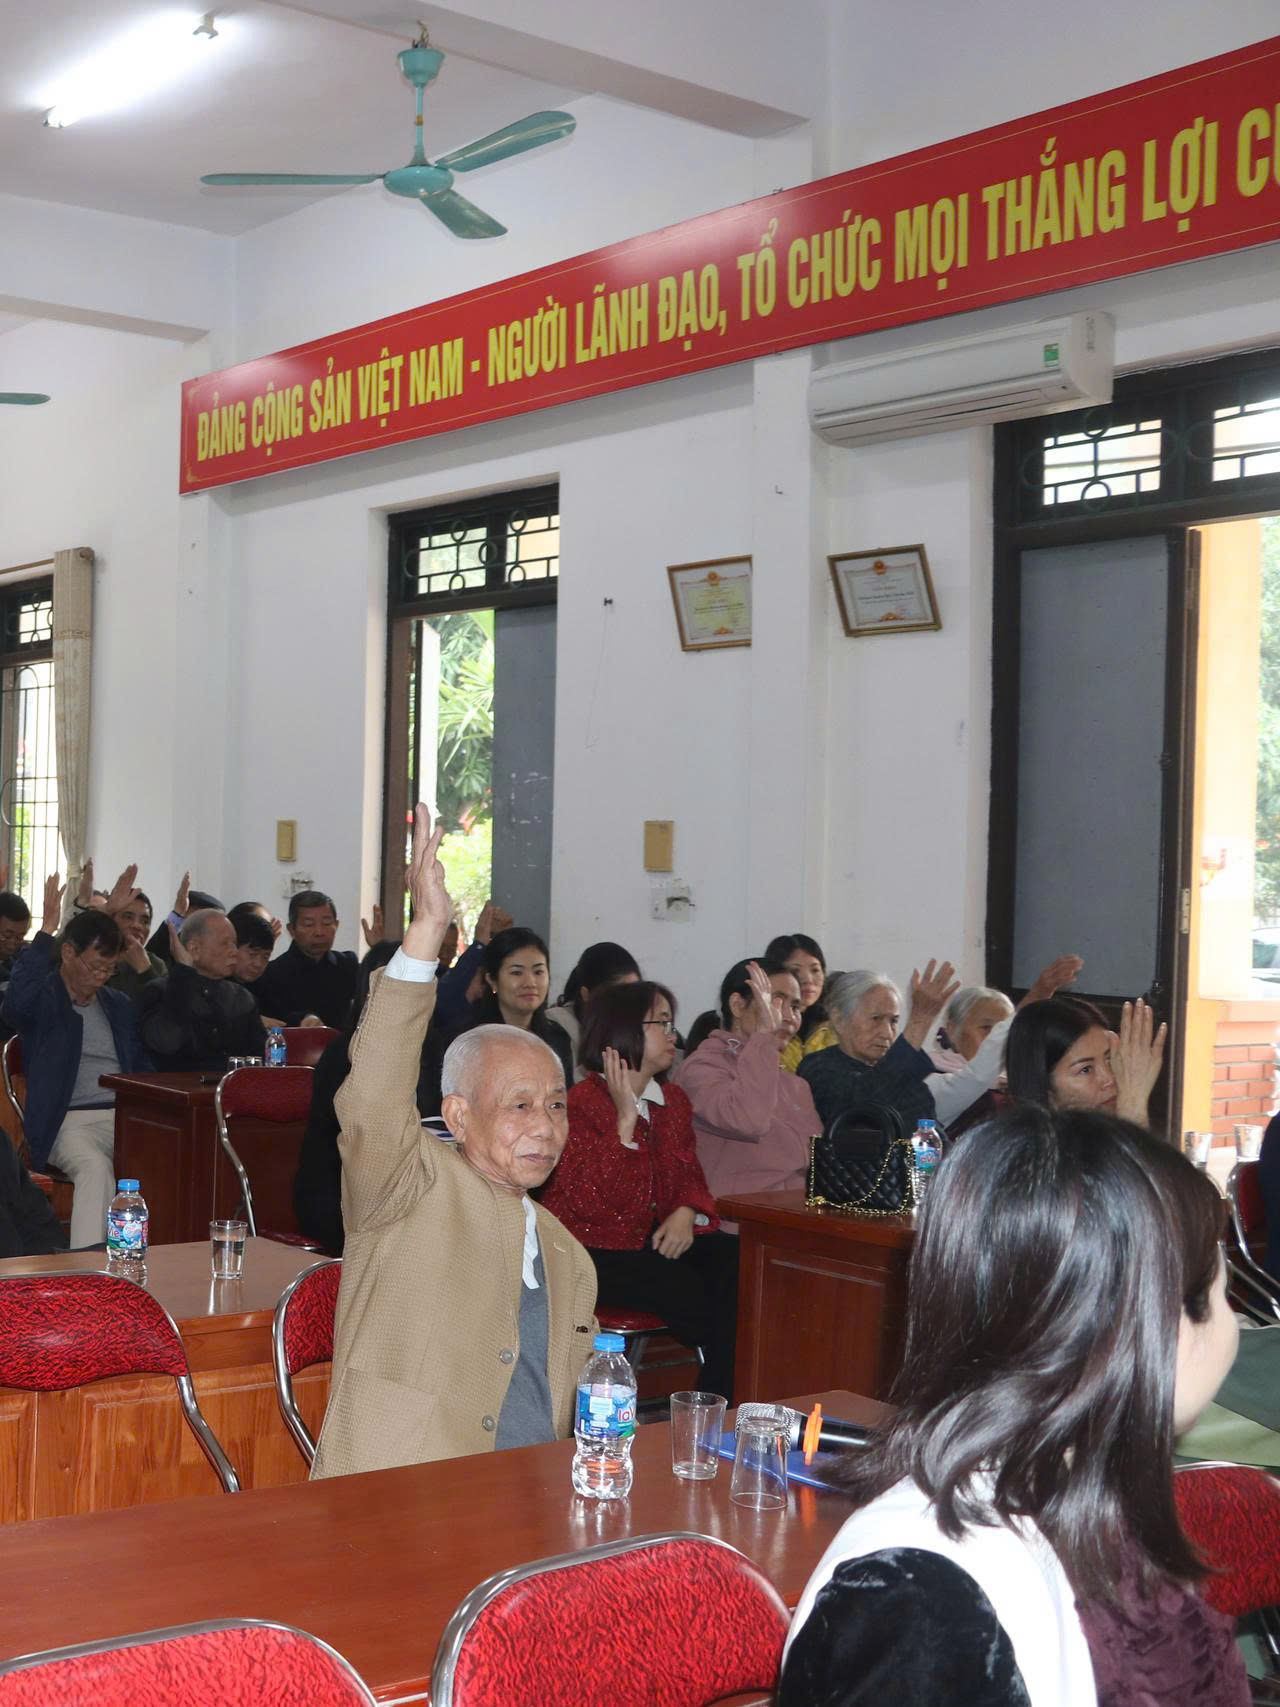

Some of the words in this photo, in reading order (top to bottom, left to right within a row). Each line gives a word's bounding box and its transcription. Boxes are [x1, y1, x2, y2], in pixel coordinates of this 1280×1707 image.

[197, 390, 246, 461] ĐẢNG
[251, 385, 304, 456] CỘNG
[309, 356, 351, 432] SẢN
[357, 348, 403, 427] VIỆT
[408, 338, 464, 407] NAM
[470, 359, 481, 373] -
[487, 295, 567, 387] NGƯỜI
[575, 284, 649, 364] LÃNH
[657, 263, 727, 352] ĐẠO,
[737, 217, 779, 321] TỔ
[788, 209, 881, 310] CHỨC
[894, 192, 969, 291] MỌI
[982, 136, 1127, 262] THẮNG
[1142, 115, 1219, 233] LỢI
[1236, 101, 1280, 198] C
